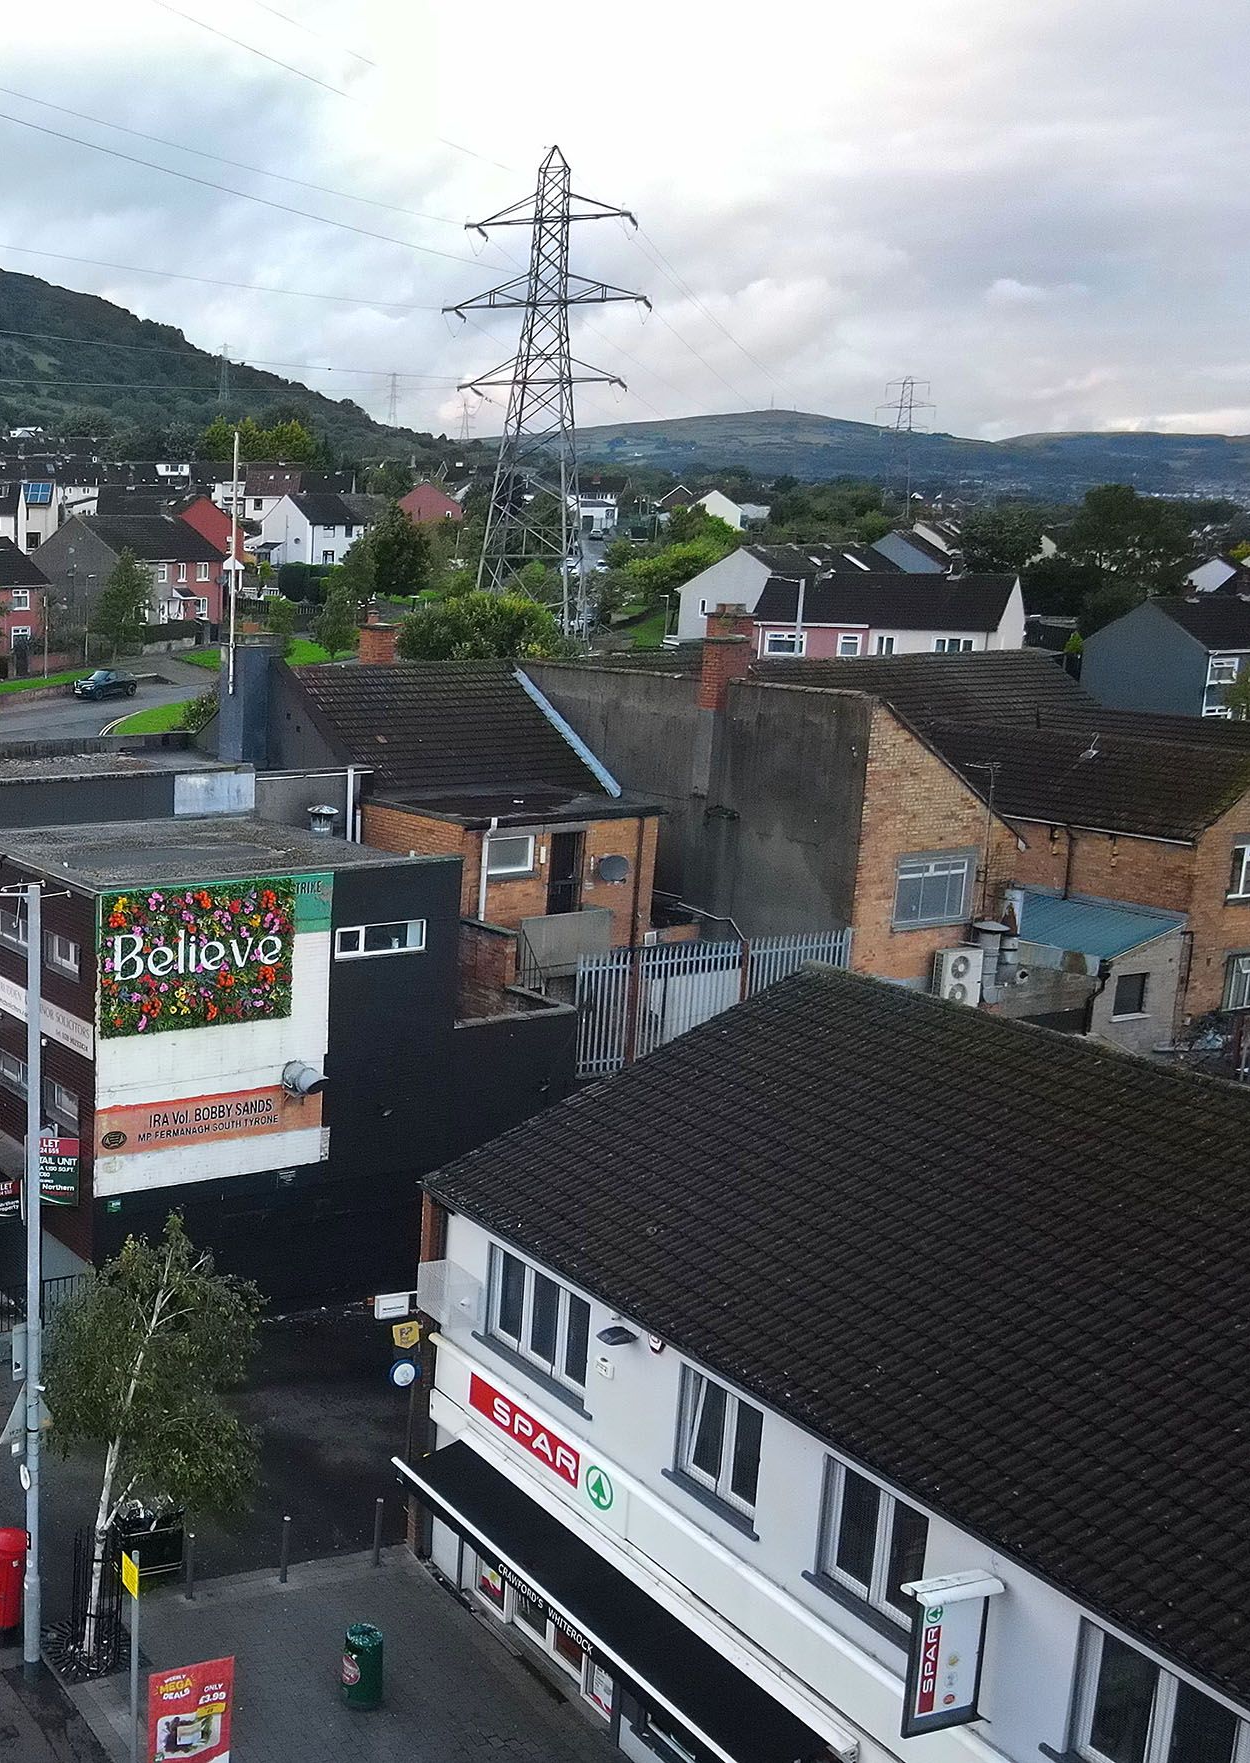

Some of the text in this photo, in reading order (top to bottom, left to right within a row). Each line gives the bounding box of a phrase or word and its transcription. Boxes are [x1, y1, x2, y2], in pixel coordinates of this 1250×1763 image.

[294, 880, 322, 895] TRIKE
[113, 929, 282, 982] Believe
[55, 1011, 90, 1039] SOLICITORS
[149, 1098, 273, 1128] IRA Vol. BOBBY SANDS
[138, 1114, 279, 1142] MP FERMANAGH SOUTH TYRONE
[43, 1139, 60, 1148] LET
[39, 1156, 78, 1166] TAIL UNIT
[0, 1182, 13, 1191] LET
[42, 1184, 75, 1192] Northern
[492, 1397, 577, 1480] SPAR
[498, 1563, 594, 1655] CRAWFORD'S WHITEROCK
[922, 1627, 939, 1694] SPAR
[158, 1678, 193, 1693] MEGA
[203, 1683, 224, 1693] ONLY
[162, 1687, 190, 1700] DEALS
[198, 1691, 227, 1705] £3.99
